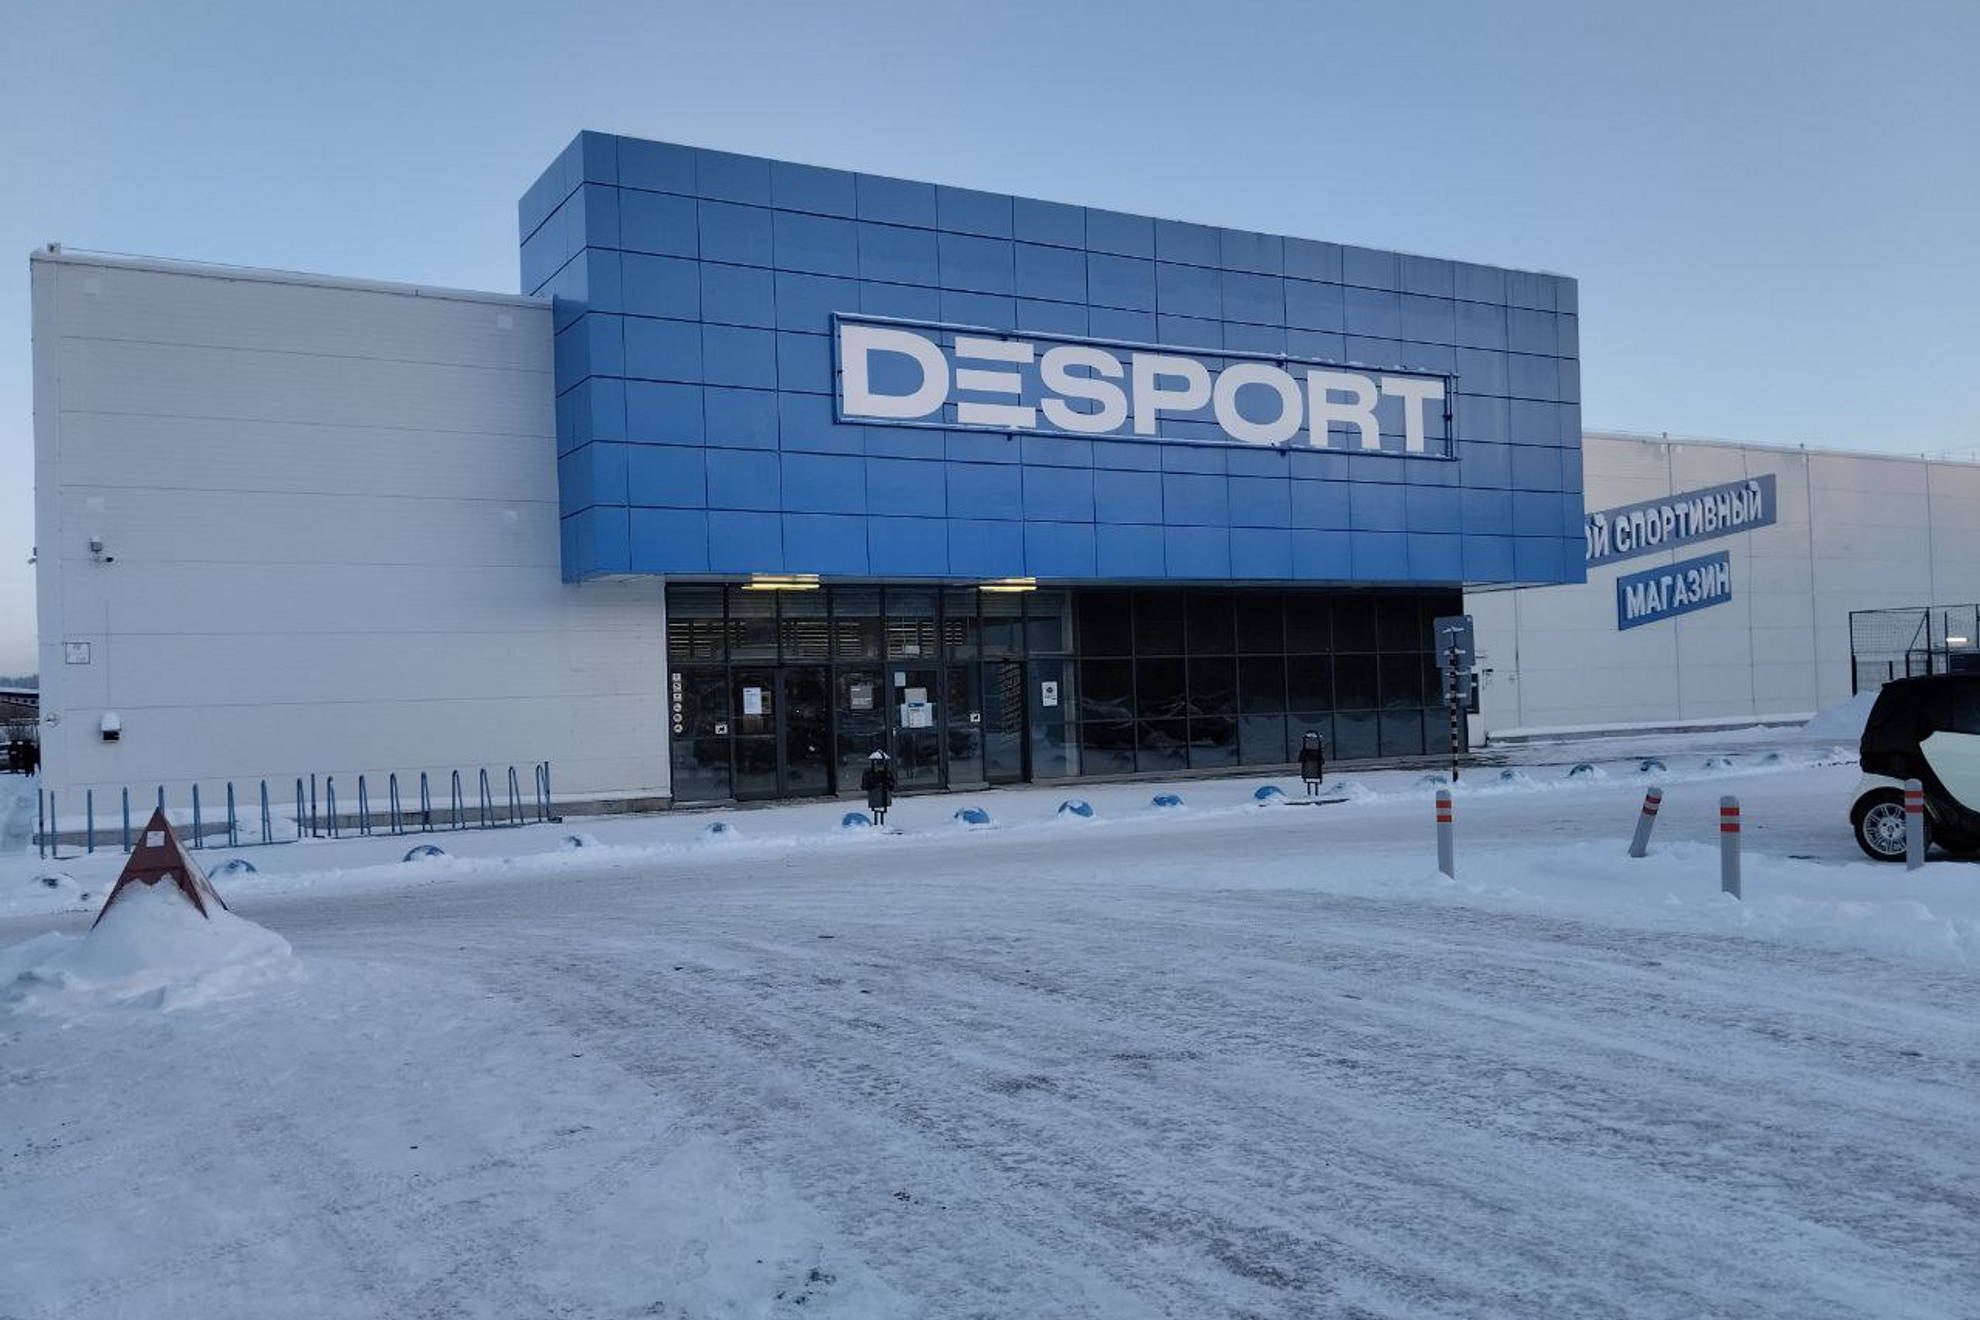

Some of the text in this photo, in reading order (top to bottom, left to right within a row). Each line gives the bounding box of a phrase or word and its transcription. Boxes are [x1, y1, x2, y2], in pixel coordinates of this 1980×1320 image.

[840, 325, 1446, 453] DESPORT
[1614, 480, 1762, 552] СПОРТИВНЫЙ
[1626, 561, 1730, 619] МАГАЗИН
